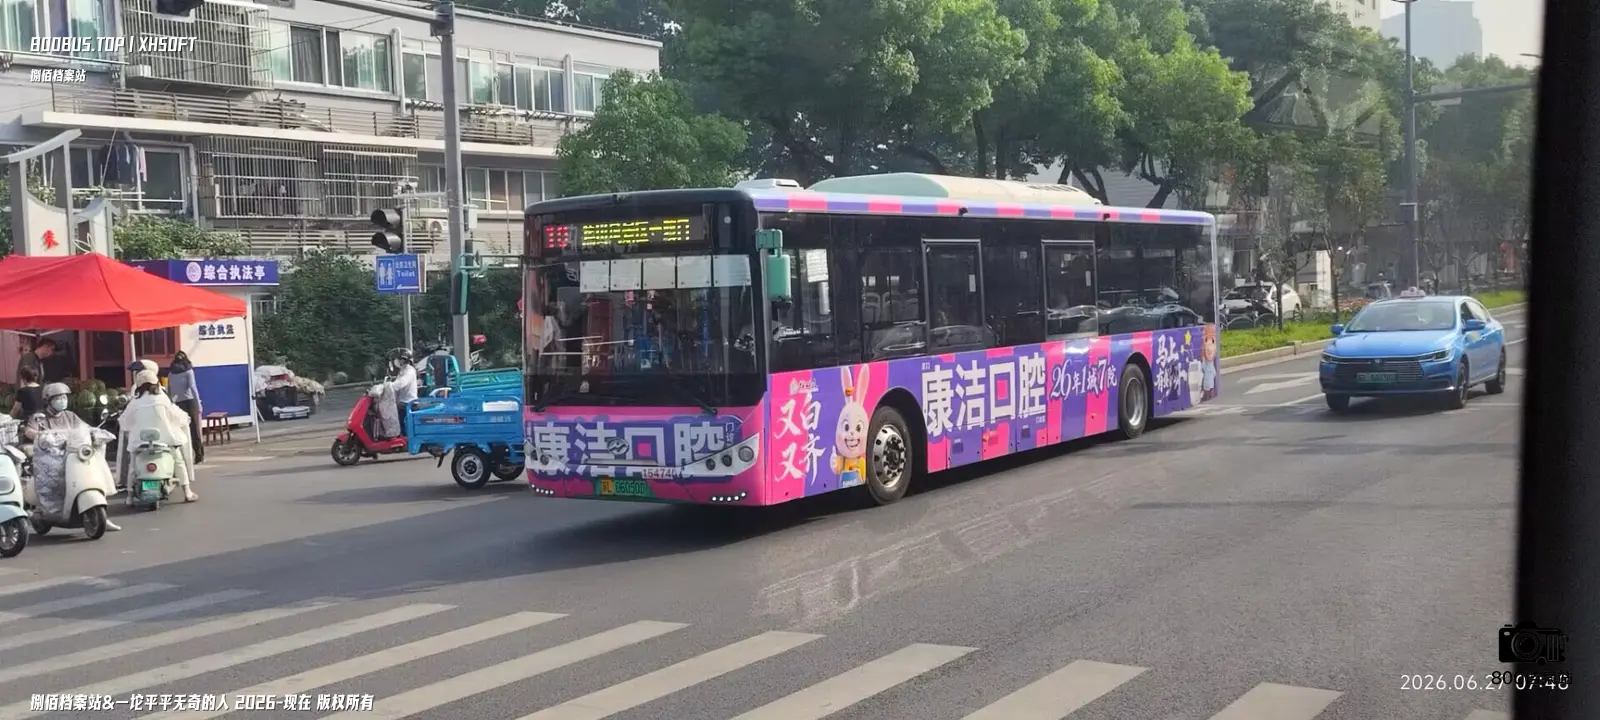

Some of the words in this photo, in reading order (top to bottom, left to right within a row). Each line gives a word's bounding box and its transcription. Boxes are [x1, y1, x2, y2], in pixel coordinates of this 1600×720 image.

[203, 264, 266, 281] 综合执法亭
[396, 270, 416, 278] Toilet
[921, 351, 1046, 437] 康洁口腔
[1049, 358, 1118, 401] 26年1城7院
[530, 421, 725, 478] 康洁口腔
